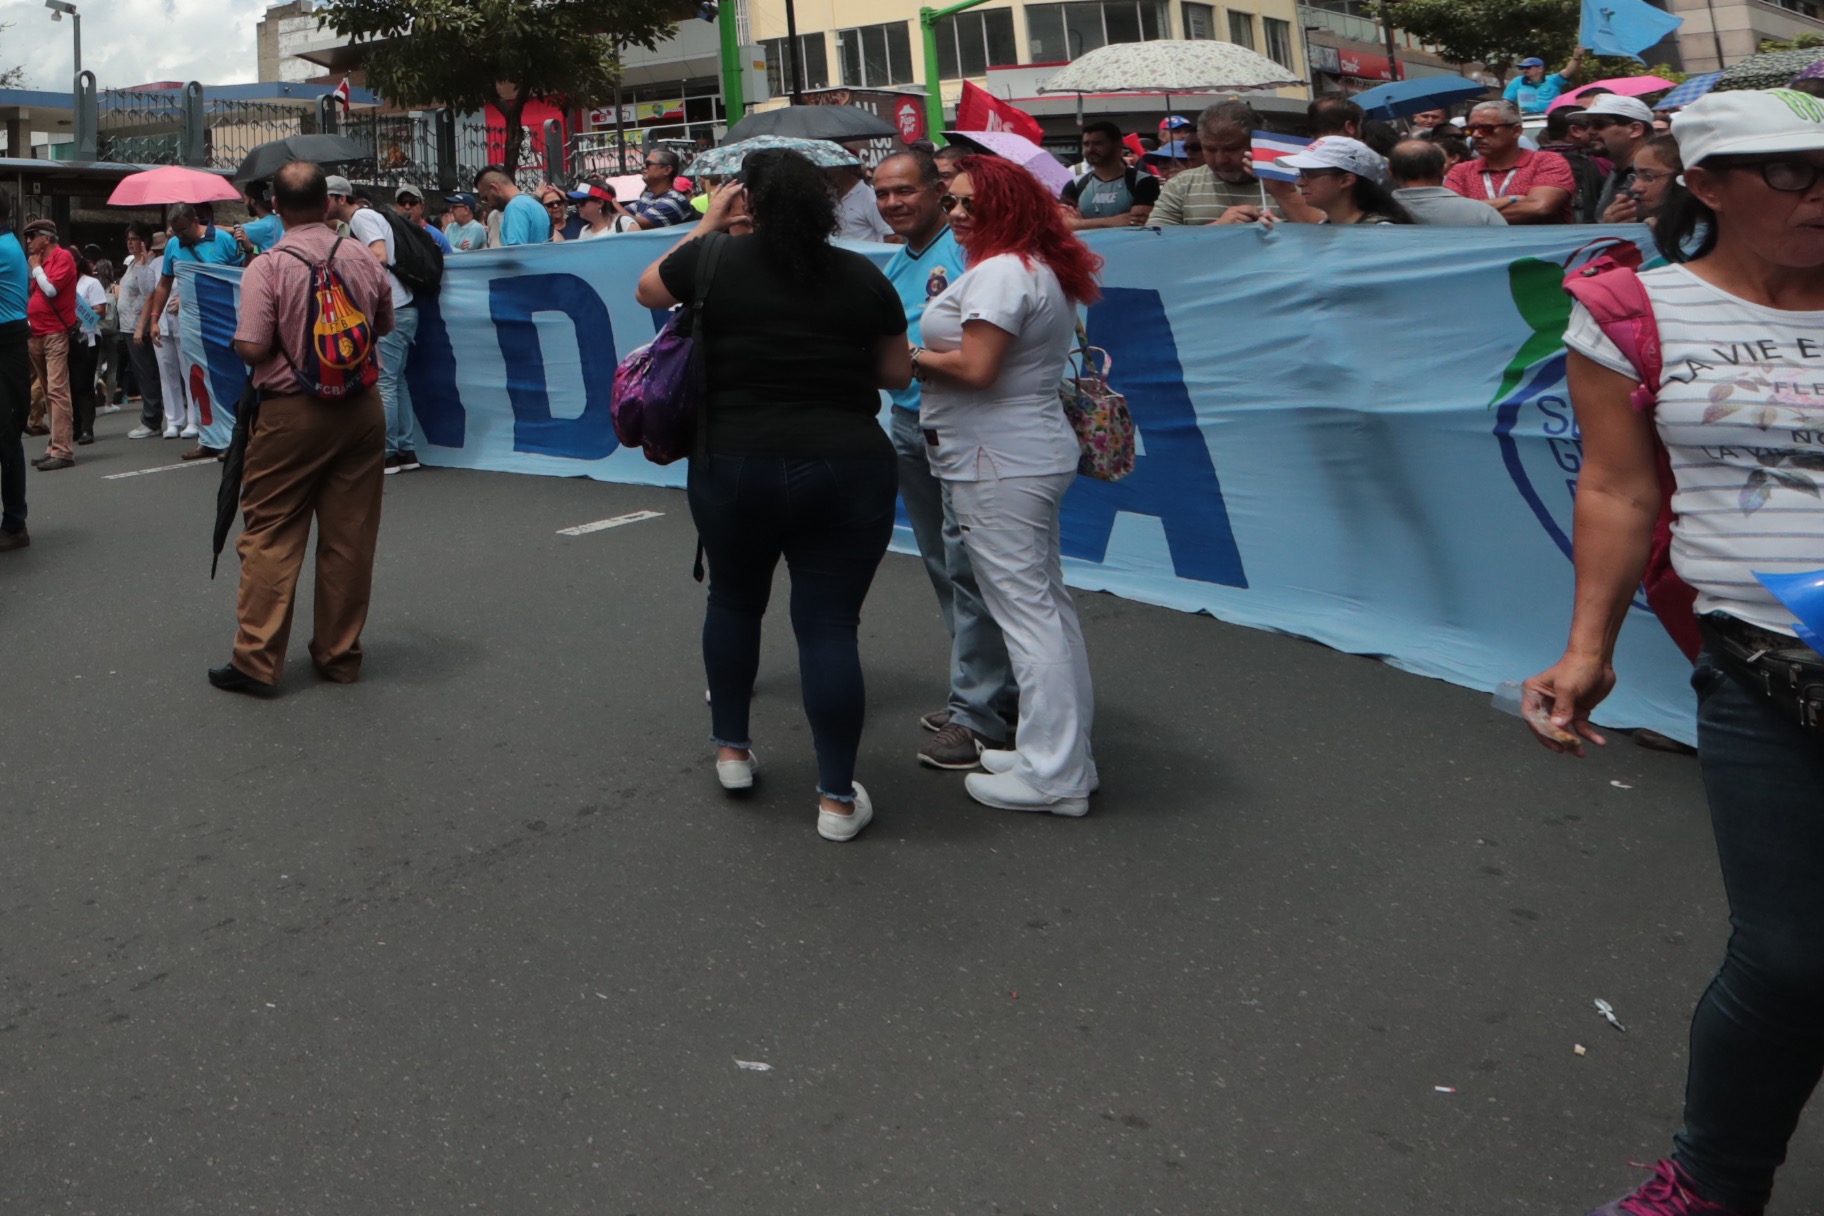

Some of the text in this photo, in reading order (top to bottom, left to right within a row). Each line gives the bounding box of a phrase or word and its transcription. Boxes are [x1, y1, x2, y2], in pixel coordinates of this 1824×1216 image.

[900, 114, 916, 128] Pizza
[903, 124, 916, 136] Hut
[1092, 192, 1118, 203] NIKE
[1667, 358, 1715, 385] LA
[1711, 339, 1784, 366] VIE
